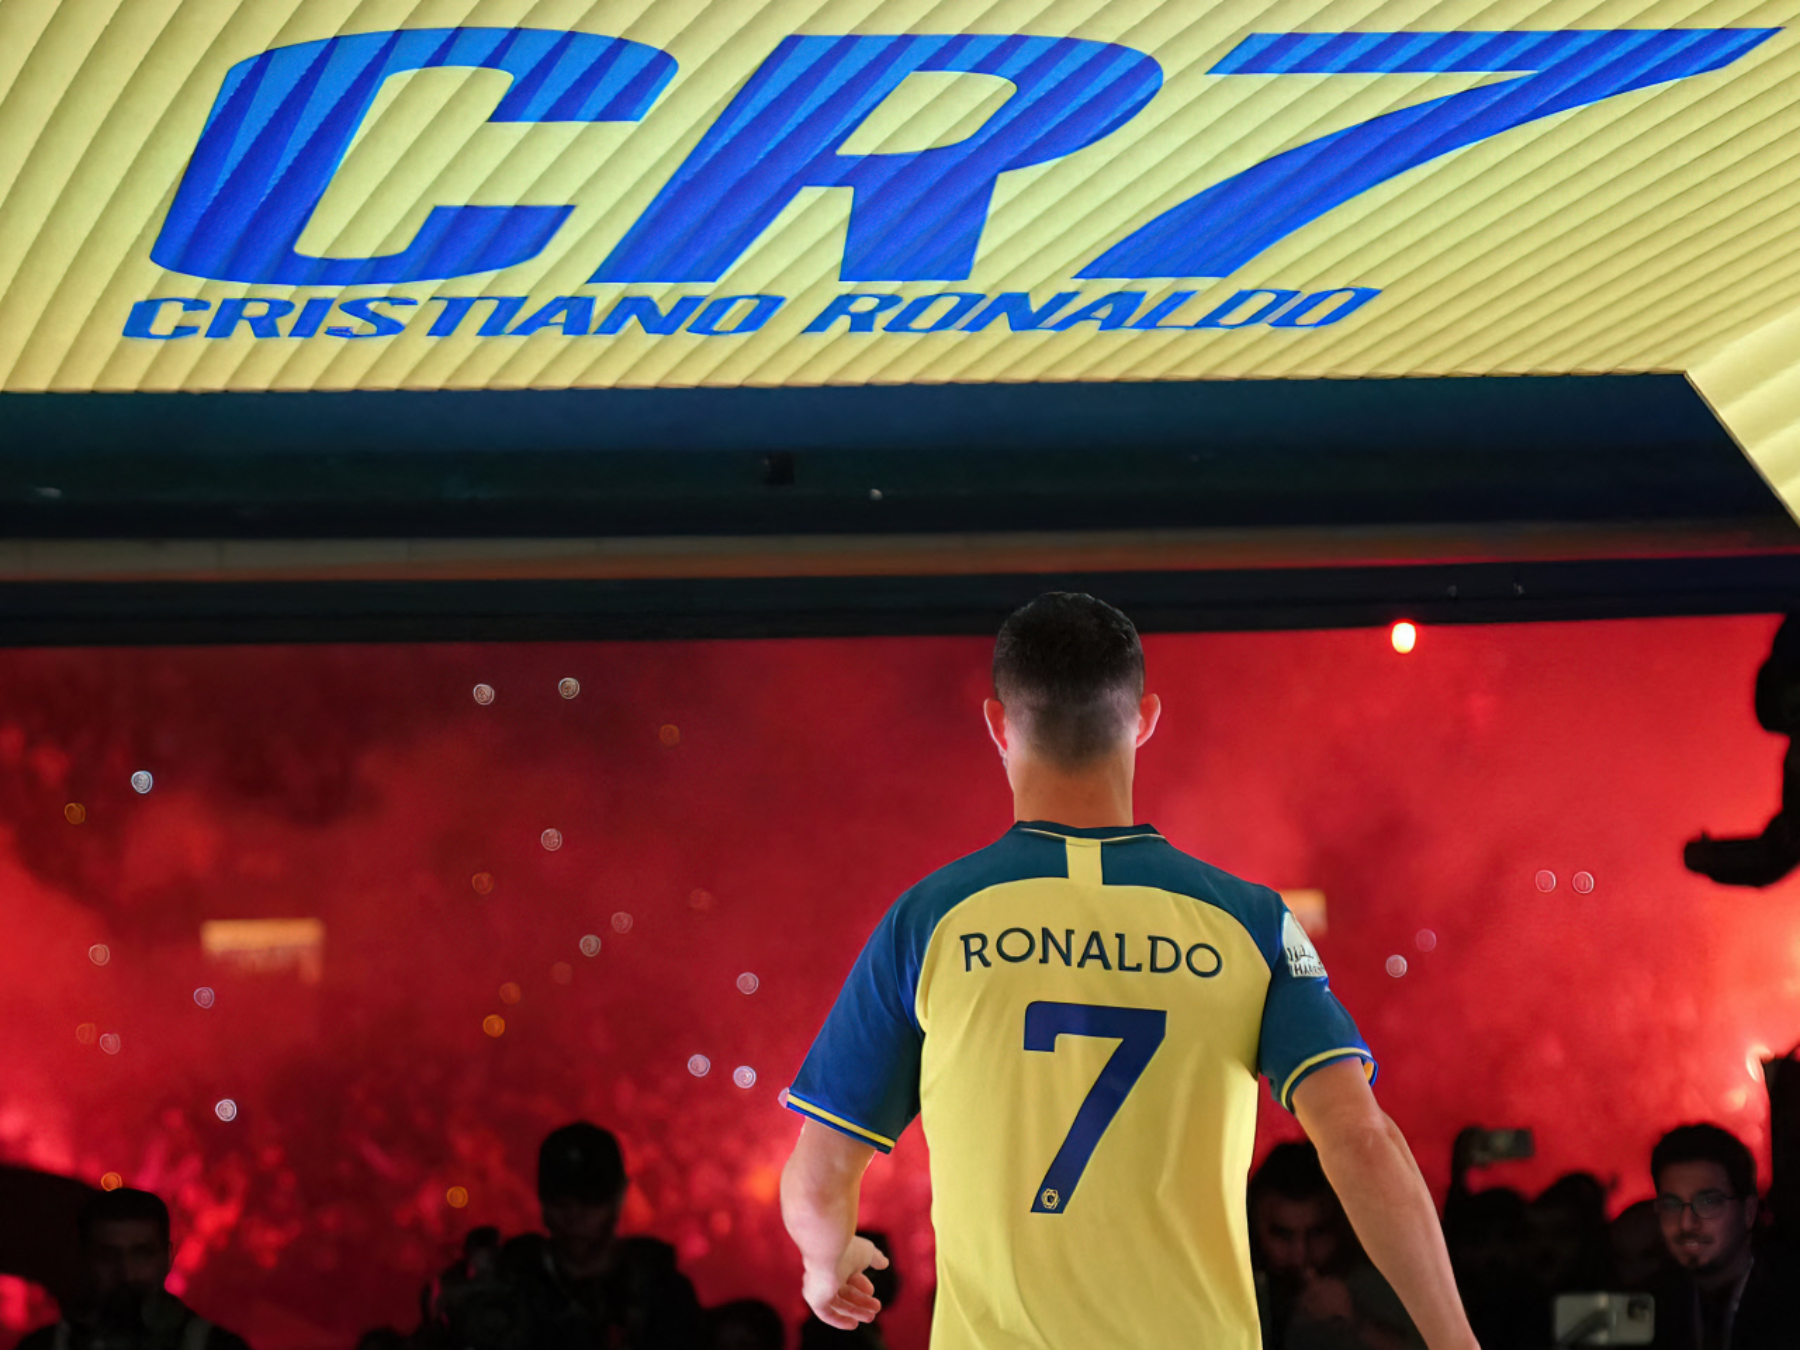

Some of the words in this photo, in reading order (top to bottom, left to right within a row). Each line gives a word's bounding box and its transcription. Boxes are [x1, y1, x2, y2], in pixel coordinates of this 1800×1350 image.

[149, 26, 1786, 286] CR7
[122, 295, 787, 340] CRISTIANO
[800, 287, 1384, 335] RONALDO
[959, 927, 1223, 978] RONALDO
[1023, 1001, 1168, 1214] 7
